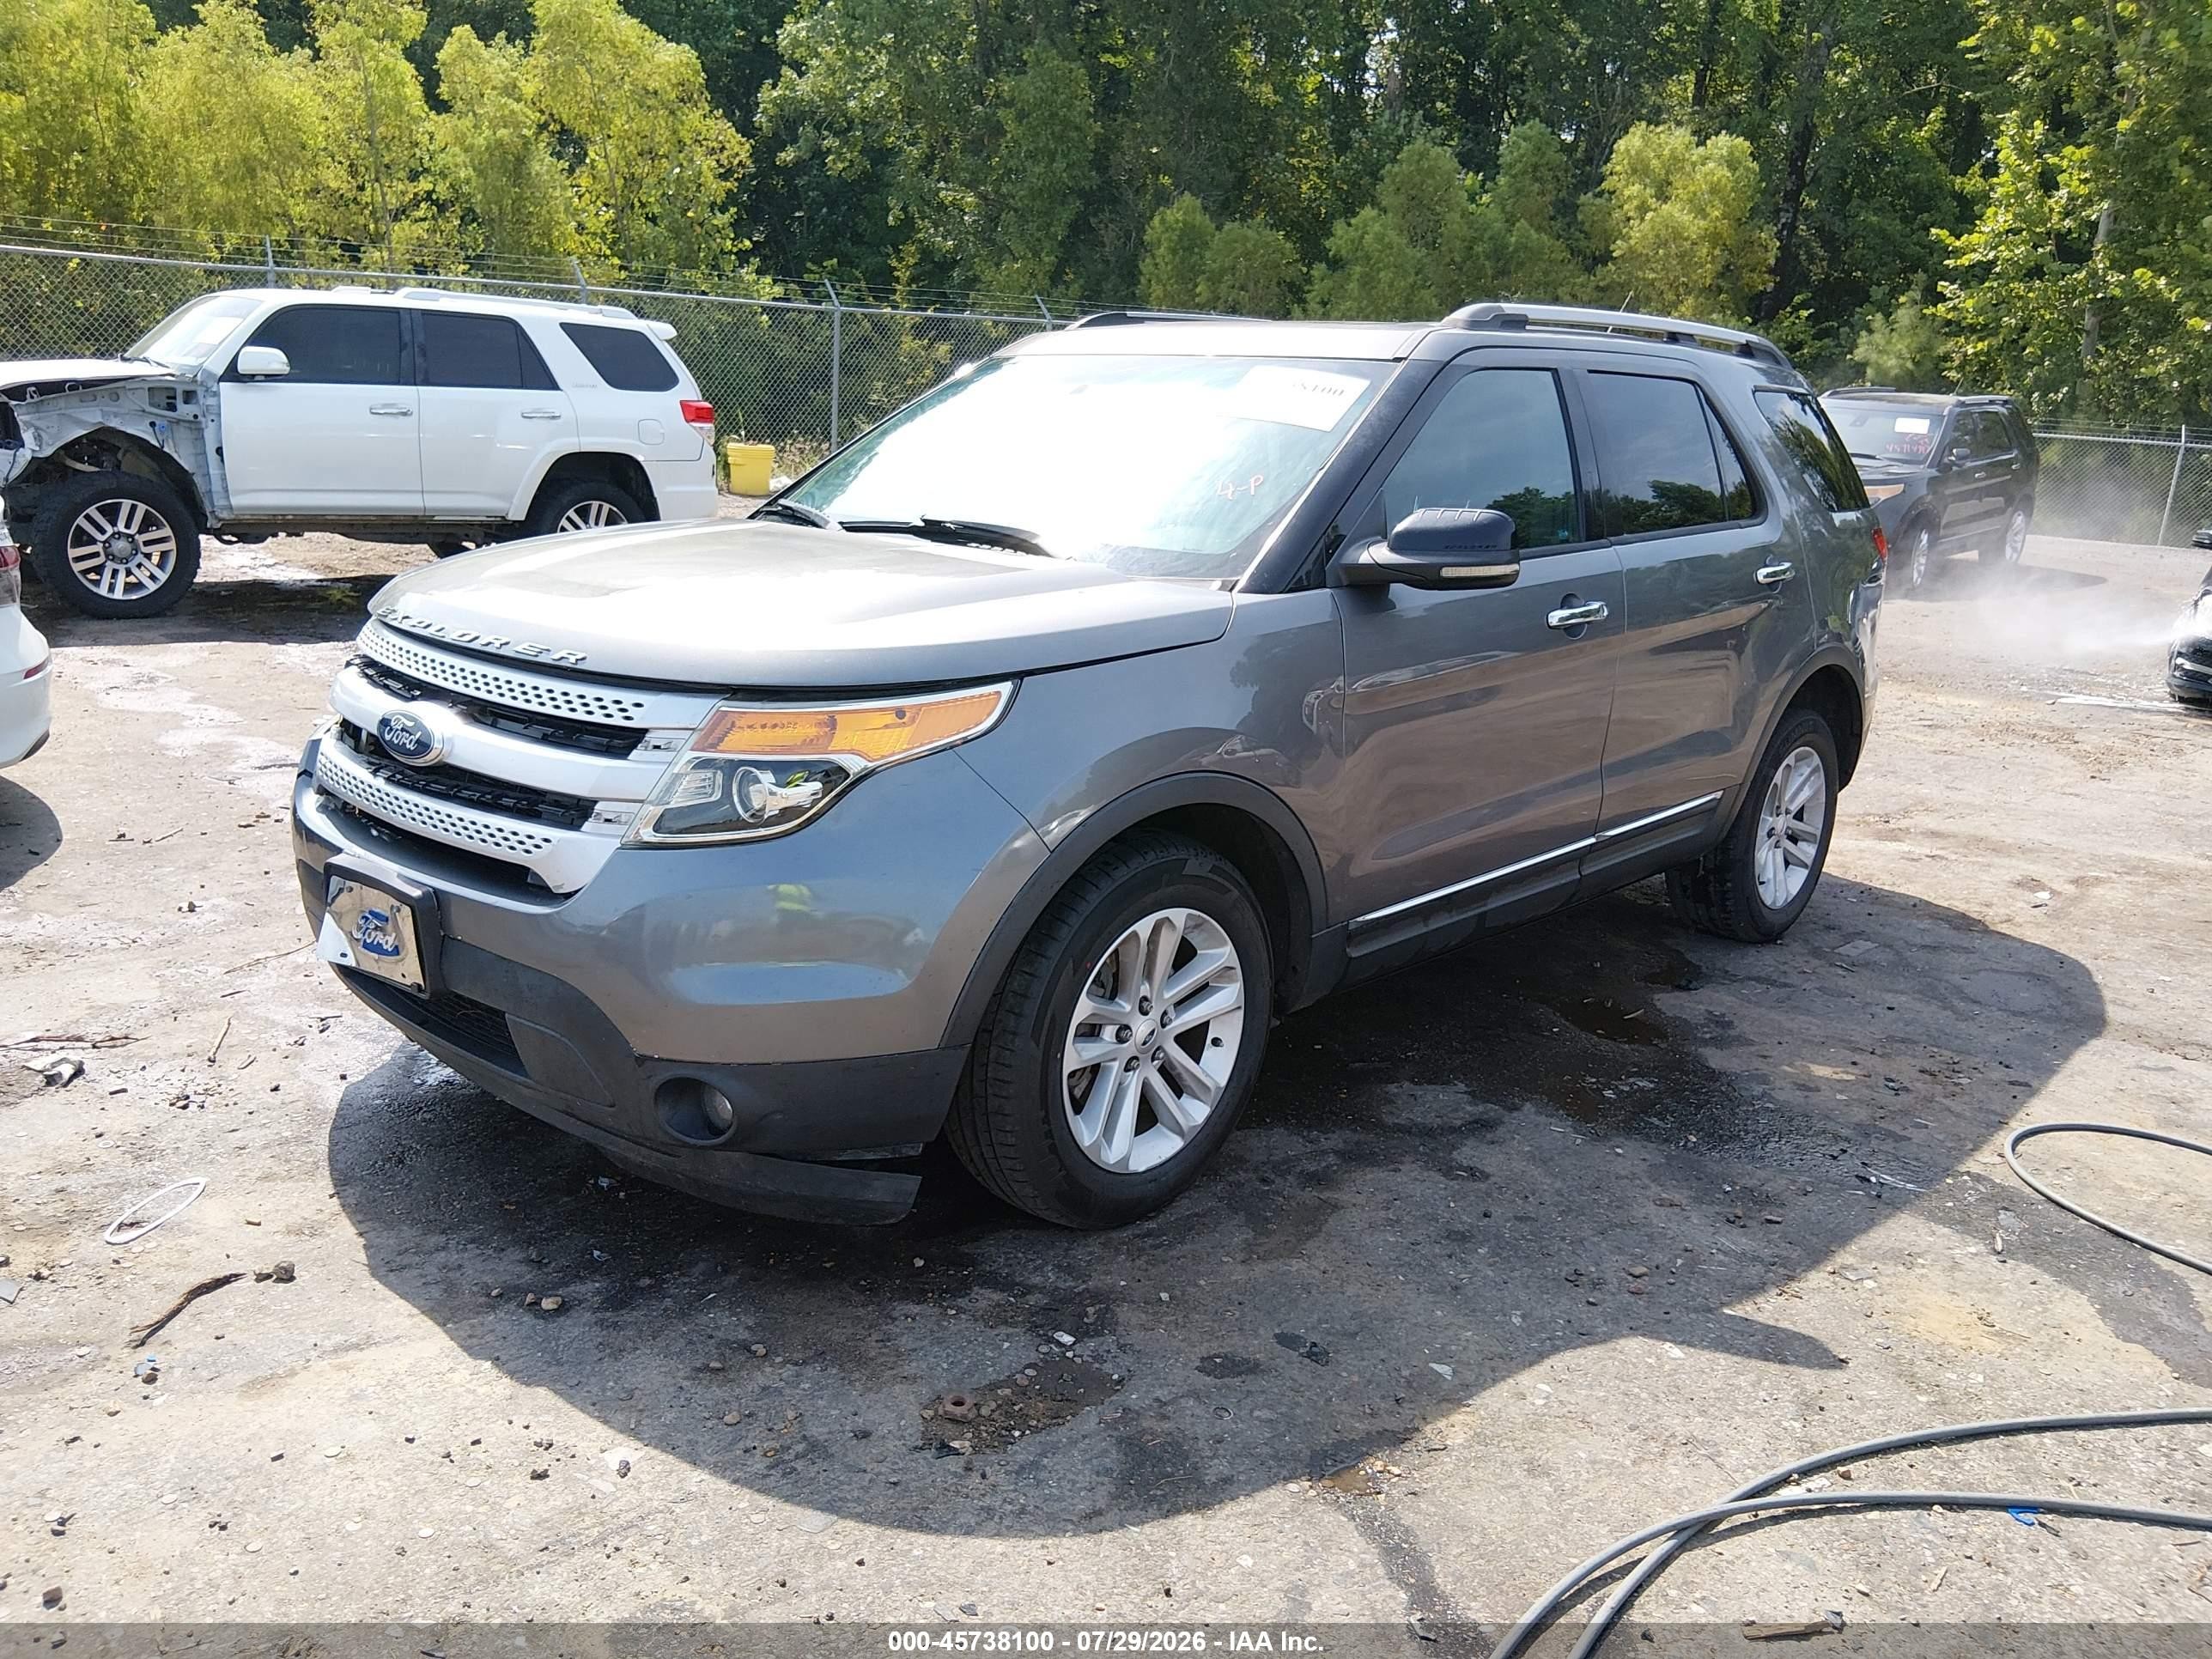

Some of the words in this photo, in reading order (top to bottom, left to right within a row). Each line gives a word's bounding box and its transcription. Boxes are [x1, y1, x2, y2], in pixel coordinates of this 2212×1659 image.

[376, 605, 588, 665] EXPLORER
[384, 714, 422, 750] Ford
[352, 911, 398, 952] Ford
